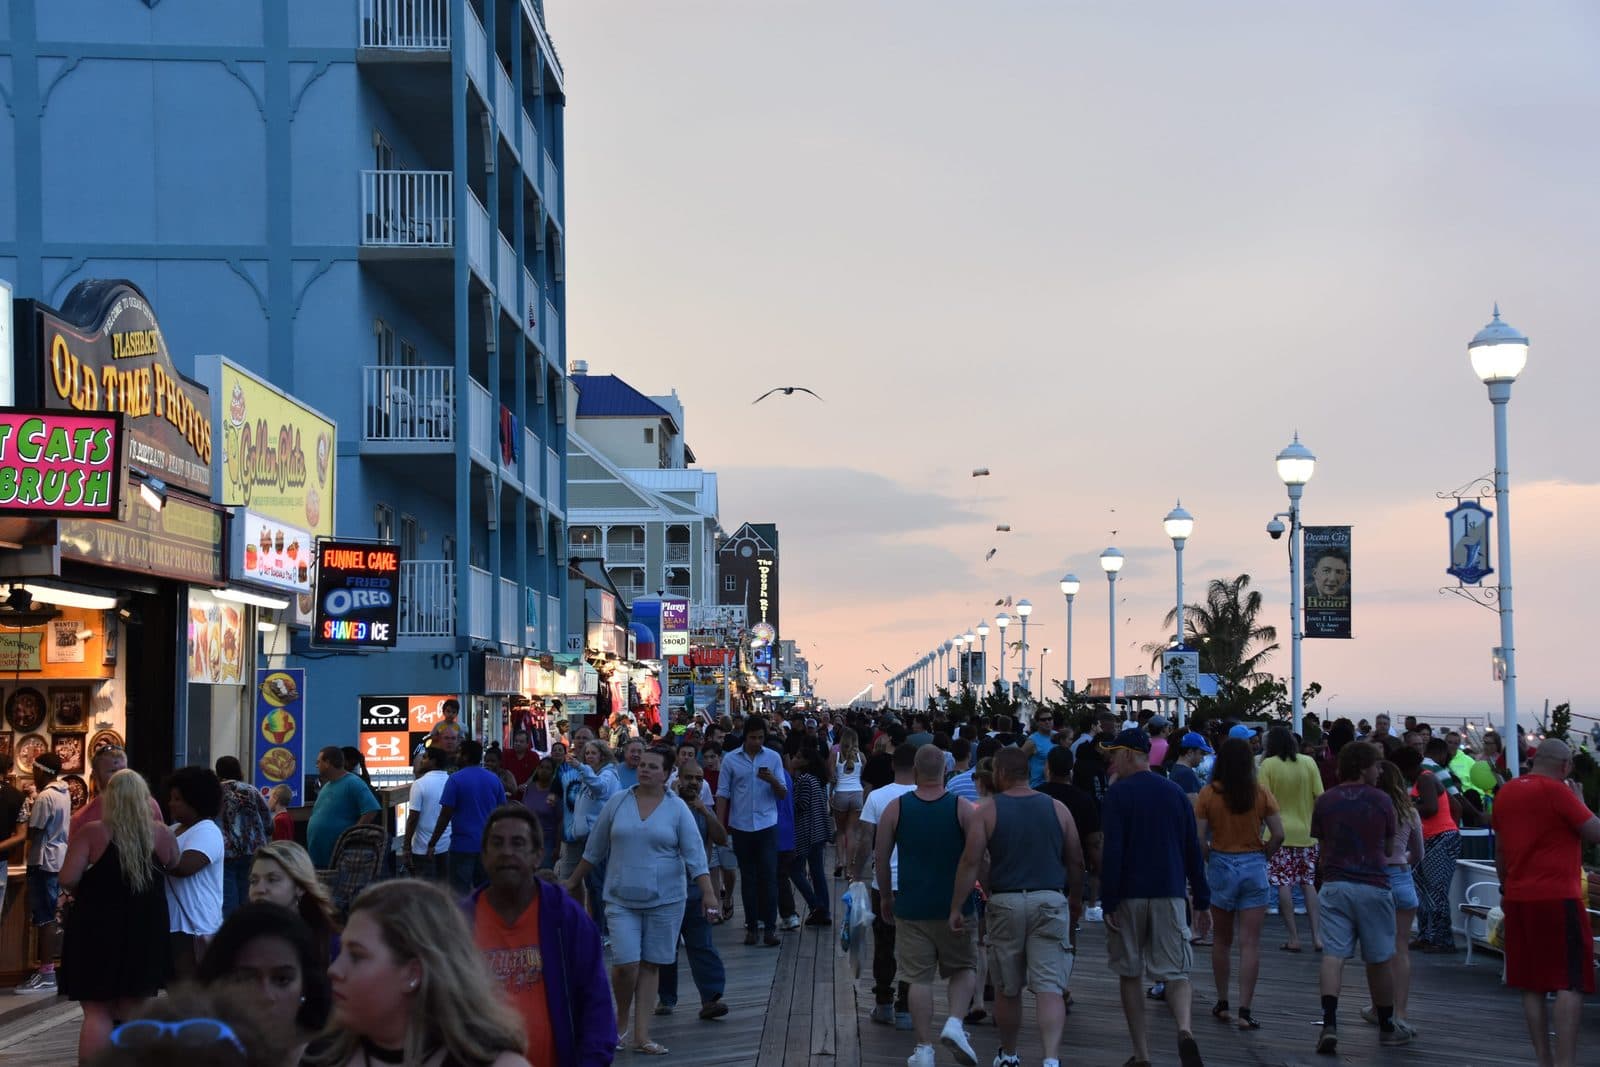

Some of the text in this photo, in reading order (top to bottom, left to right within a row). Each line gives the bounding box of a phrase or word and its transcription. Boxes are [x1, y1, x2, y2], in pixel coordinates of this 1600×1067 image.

[112, 330, 158, 359] FLASHBACK
[52, 334, 98, 411] OLD
[102, 365, 151, 418] TIME
[153, 362, 211, 466] PHOTOS
[17, 417, 112, 464] CATS
[0, 466, 111, 507] BRUSH
[1461, 513, 1476, 537] 1st
[324, 549, 398, 571] FUNNEL CAKE
[346, 576, 390, 588] FRIED
[758, 566, 770, 598] Dough
[326, 590, 390, 615] OREO
[323, 620, 389, 641] SHAVED ICE
[362, 717, 408, 725] OAKLEY
